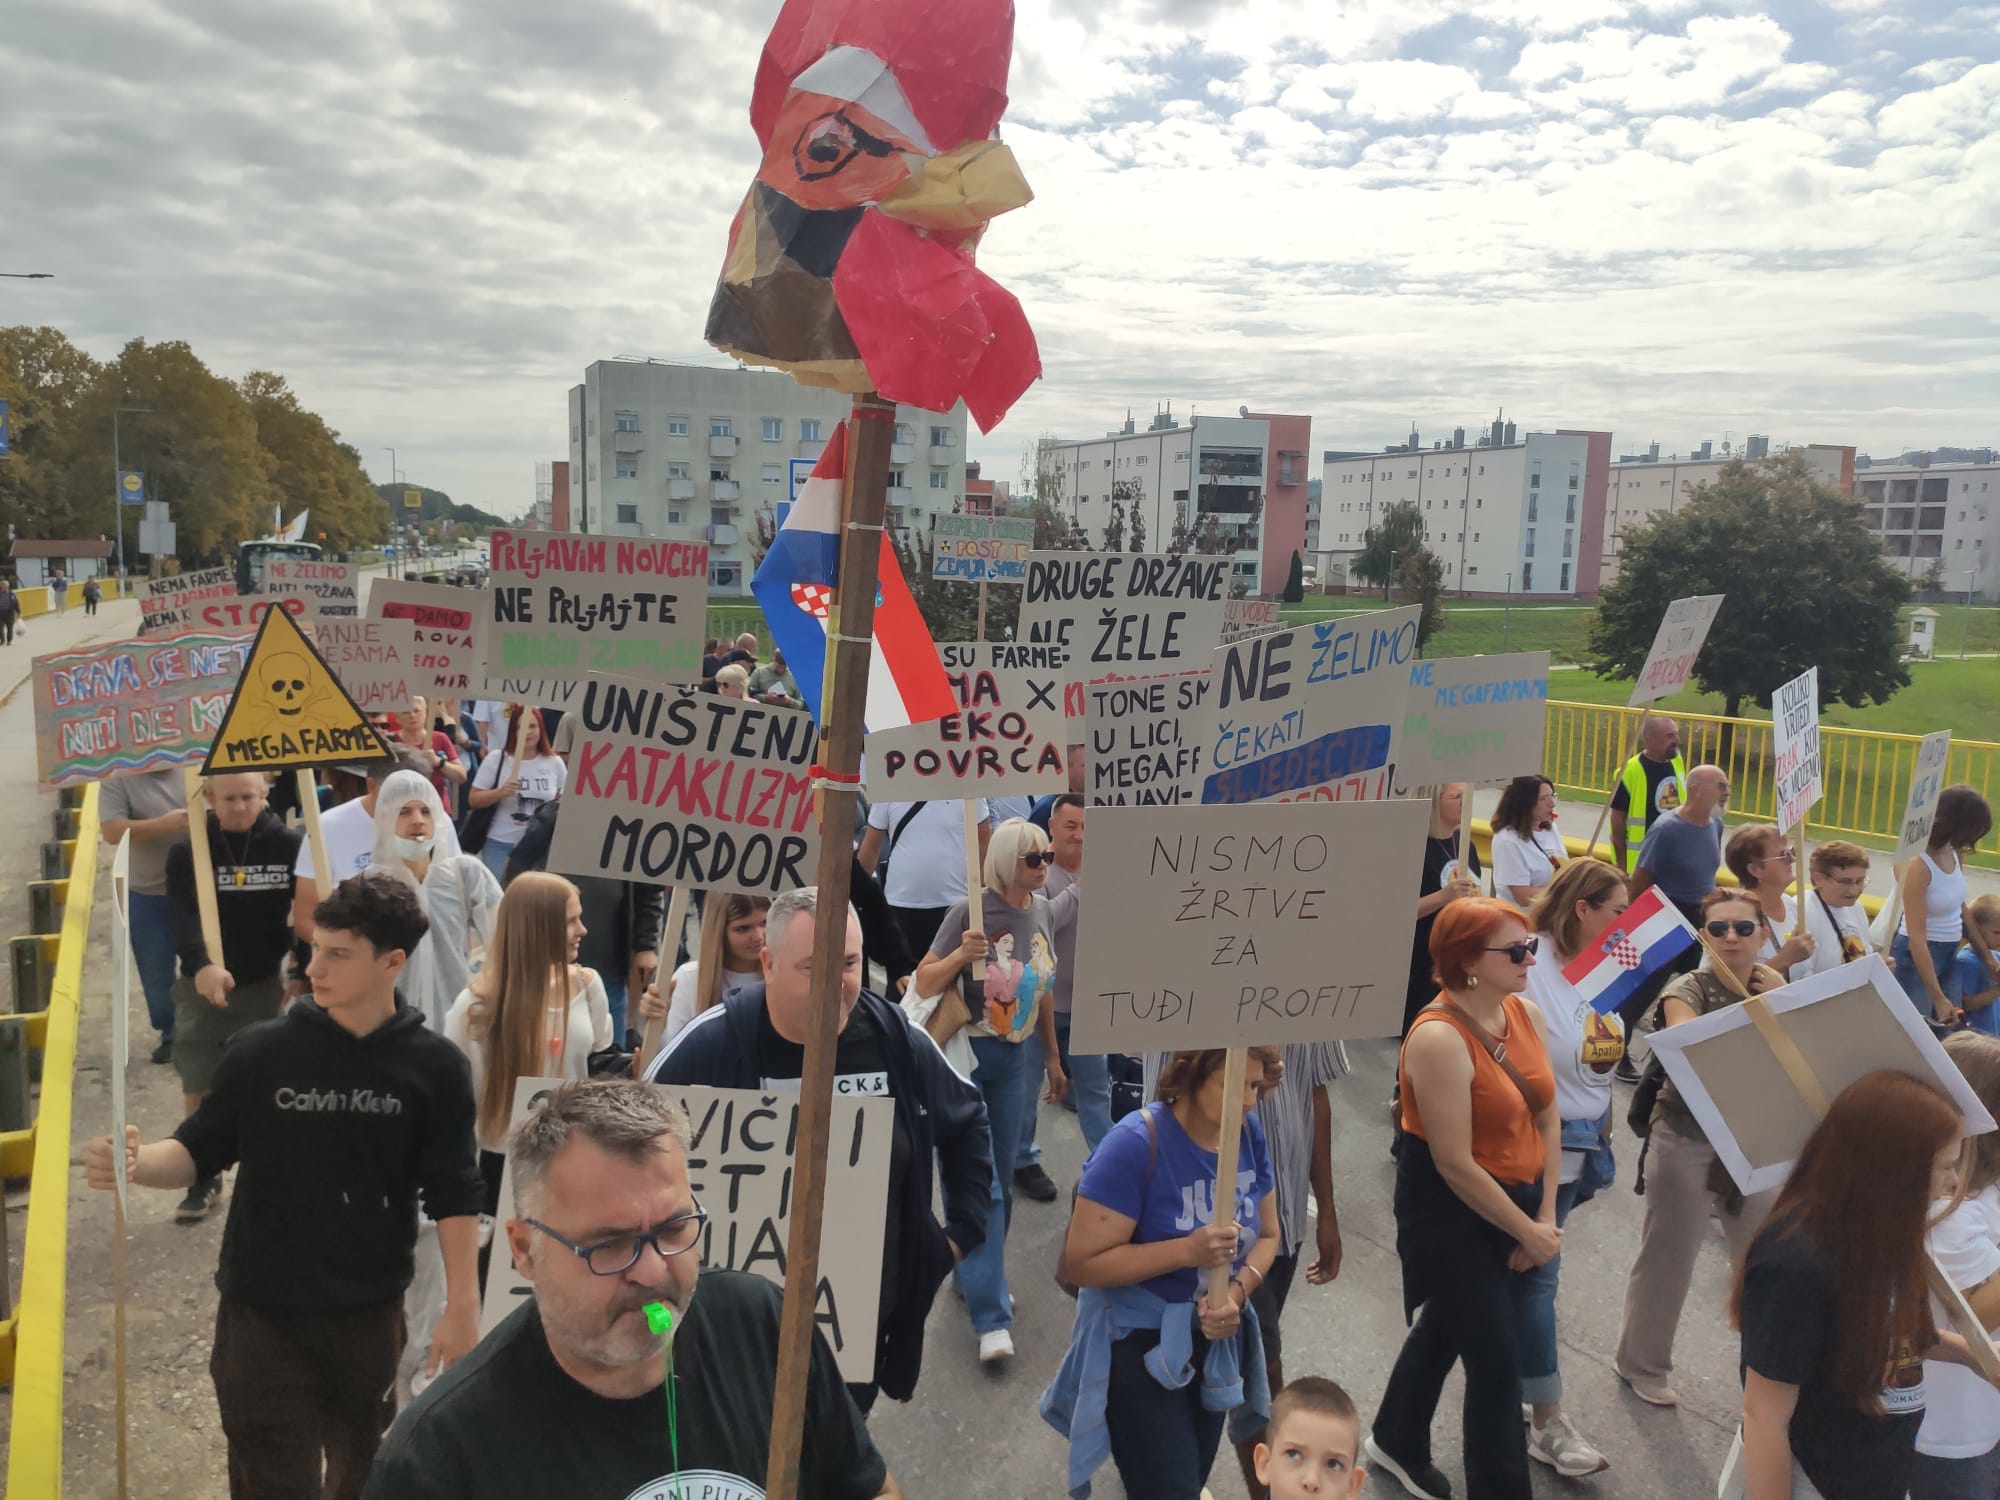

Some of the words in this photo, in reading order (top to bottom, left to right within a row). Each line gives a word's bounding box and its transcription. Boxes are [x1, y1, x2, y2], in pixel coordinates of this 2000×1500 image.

[270, 563, 286, 577] NE
[616, 541, 709, 578] NOVCEM
[149, 577, 189, 596] NEMA
[189, 567, 233, 588] FARME
[304, 583, 356, 599] RŽAVA
[1026, 557, 1122, 603] DRUGE
[1126, 554, 1229, 601] DRŽAVE
[143, 611, 181, 629] NEMA
[495, 587, 533, 623] NE
[1090, 607, 1186, 663] ŽELE
[943, 646, 976, 667] SU
[1219, 632, 1294, 709] NE
[1306, 620, 1417, 684] ŽELIMO
[1409, 662, 1435, 688] NE
[53, 652, 141, 707] DRAVA
[147, 647, 183, 687] SE
[1092, 684, 1166, 718] TONE
[130, 706, 181, 744] NE
[226, 733, 295, 765] MEGA
[300, 722, 379, 757] FARME
[1094, 728, 1116, 754] U
[1130, 718, 1183, 750] LICI,
[1213, 708, 1305, 769] ČEKATI
[599, 816, 808, 891] MORDOR
[1150, 834, 1328, 875] NISMO
[1175, 880, 1326, 922] ŽRTVE
[1211, 935, 1259, 966] ZA
[1097, 988, 1194, 1027] TUĐI
[1236, 983, 1375, 1024] PROFIT
[275, 1087, 347, 1112] Calvin
[349, 1088, 402, 1114] Klein
